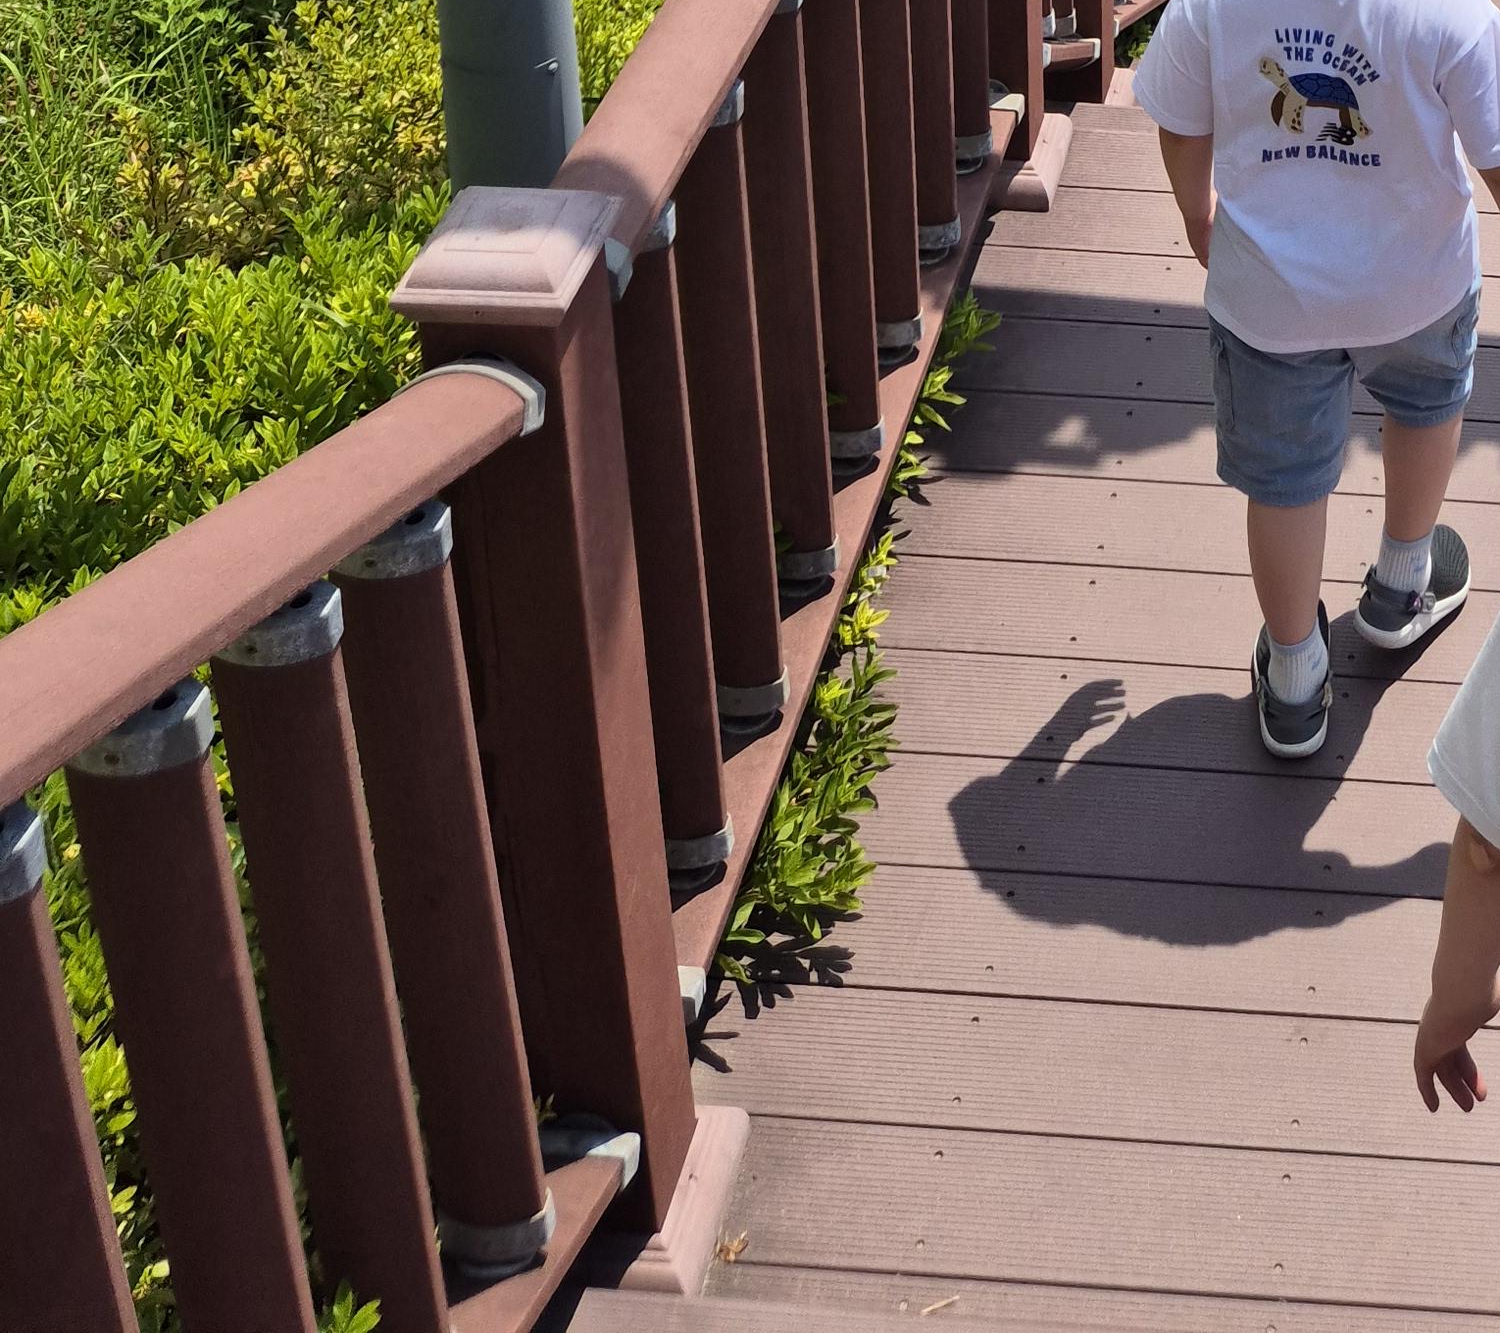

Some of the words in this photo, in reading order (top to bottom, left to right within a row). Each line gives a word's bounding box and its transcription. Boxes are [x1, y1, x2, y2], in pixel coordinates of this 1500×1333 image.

[1275, 28, 1336, 48] LIVING
[1341, 43, 1380, 83] WITH
[1283, 46, 1315, 62] THE
[1322, 51, 1368, 86] OCEAN
[1262, 146, 1301, 163] NEW
[1306, 145, 1381, 167] BALANCE
